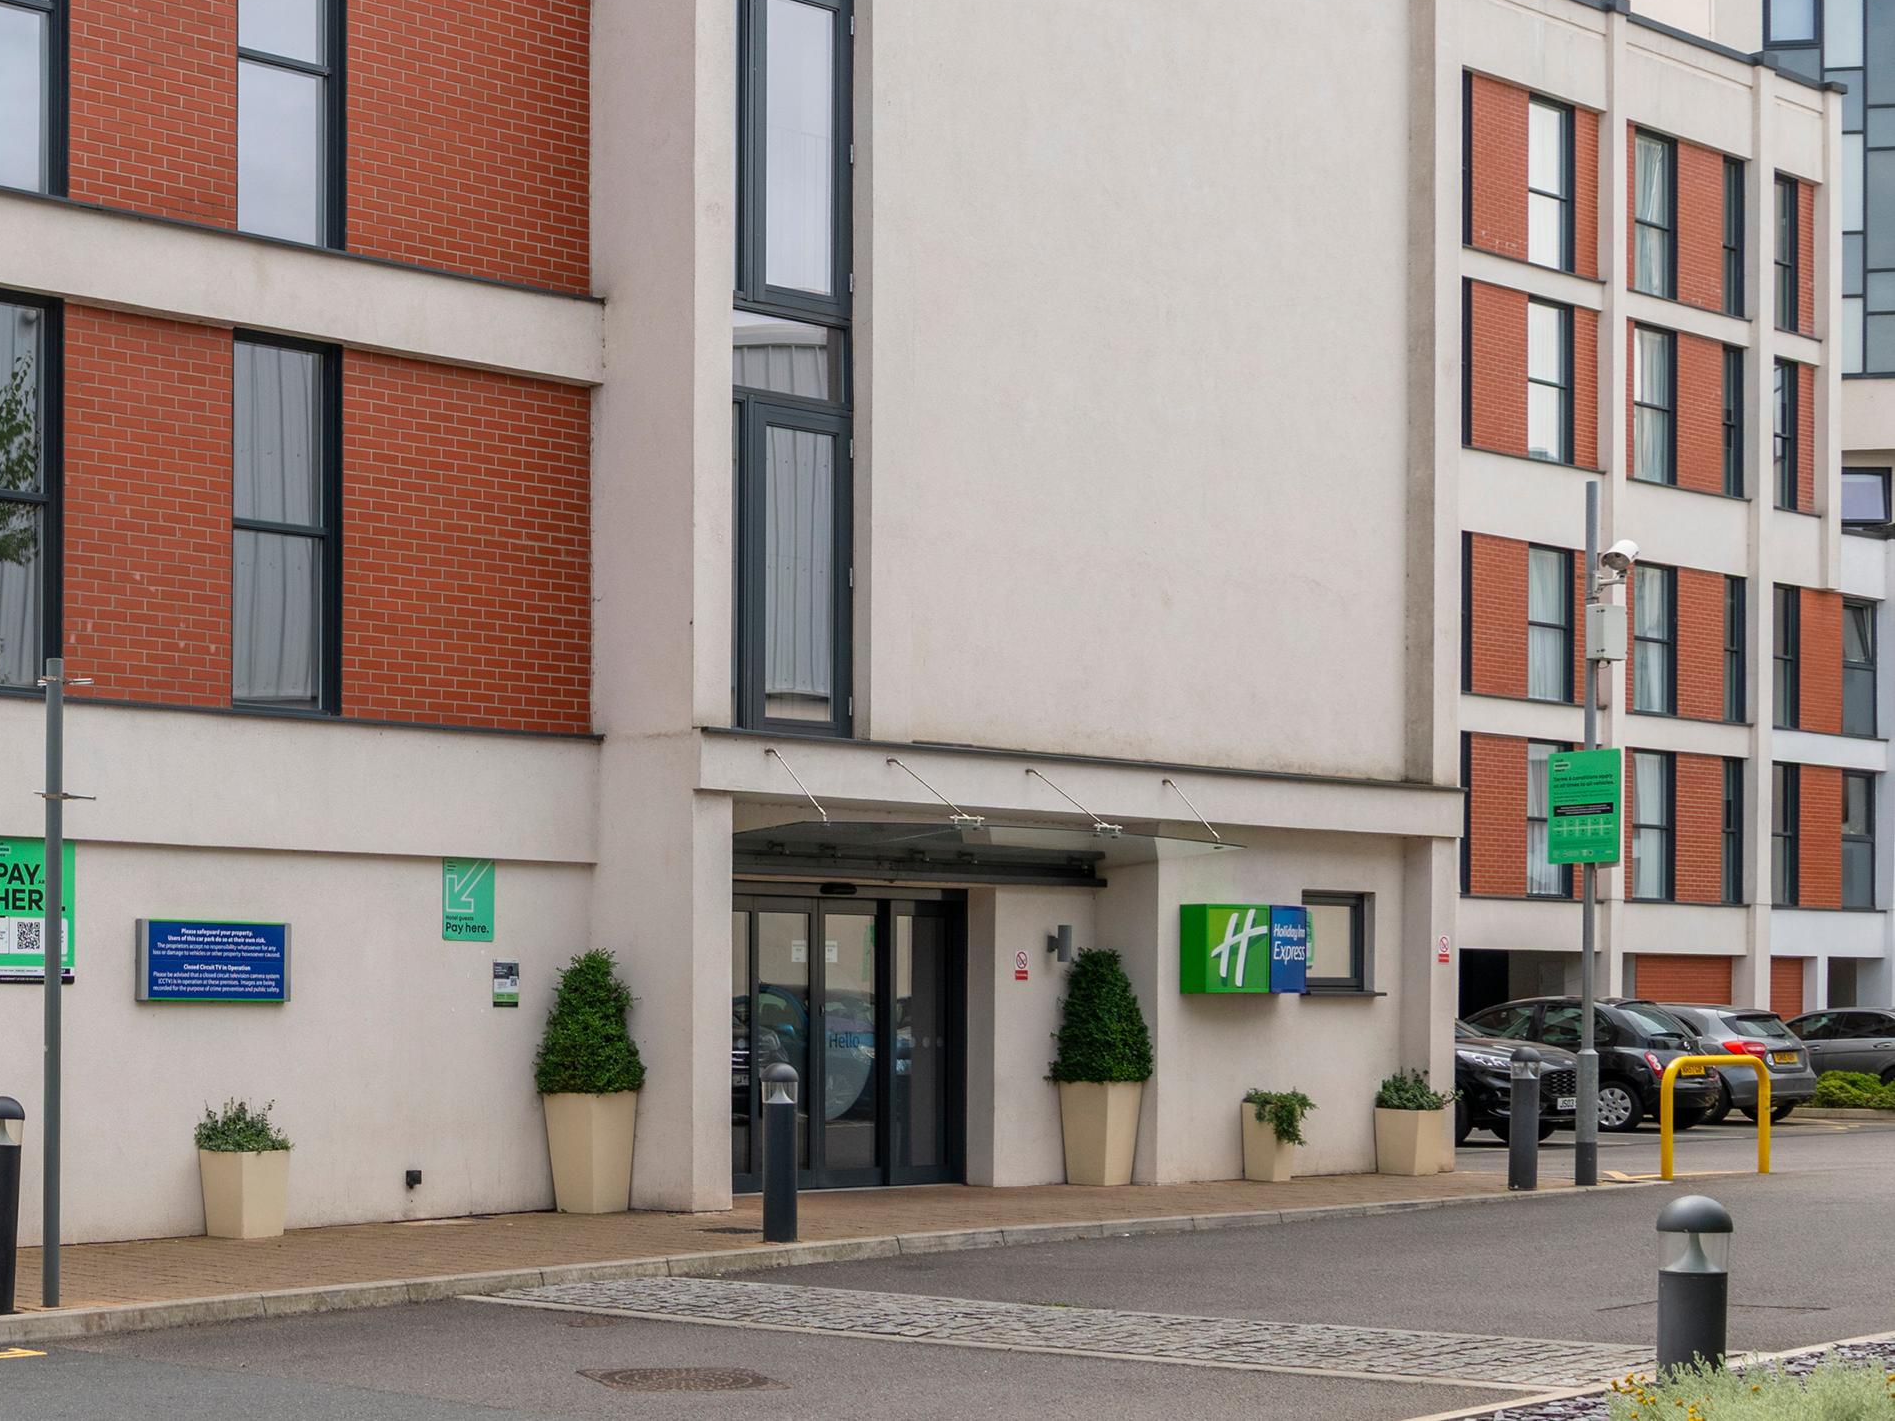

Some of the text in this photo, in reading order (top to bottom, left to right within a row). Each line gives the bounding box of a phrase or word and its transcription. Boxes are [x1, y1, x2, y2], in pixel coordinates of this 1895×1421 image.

[446, 922, 489, 934] Pay here.
[1273, 923, 1298, 941] Holiday
[1273, 941, 1306, 965] Express
[829, 1032, 859, 1048] Hello
